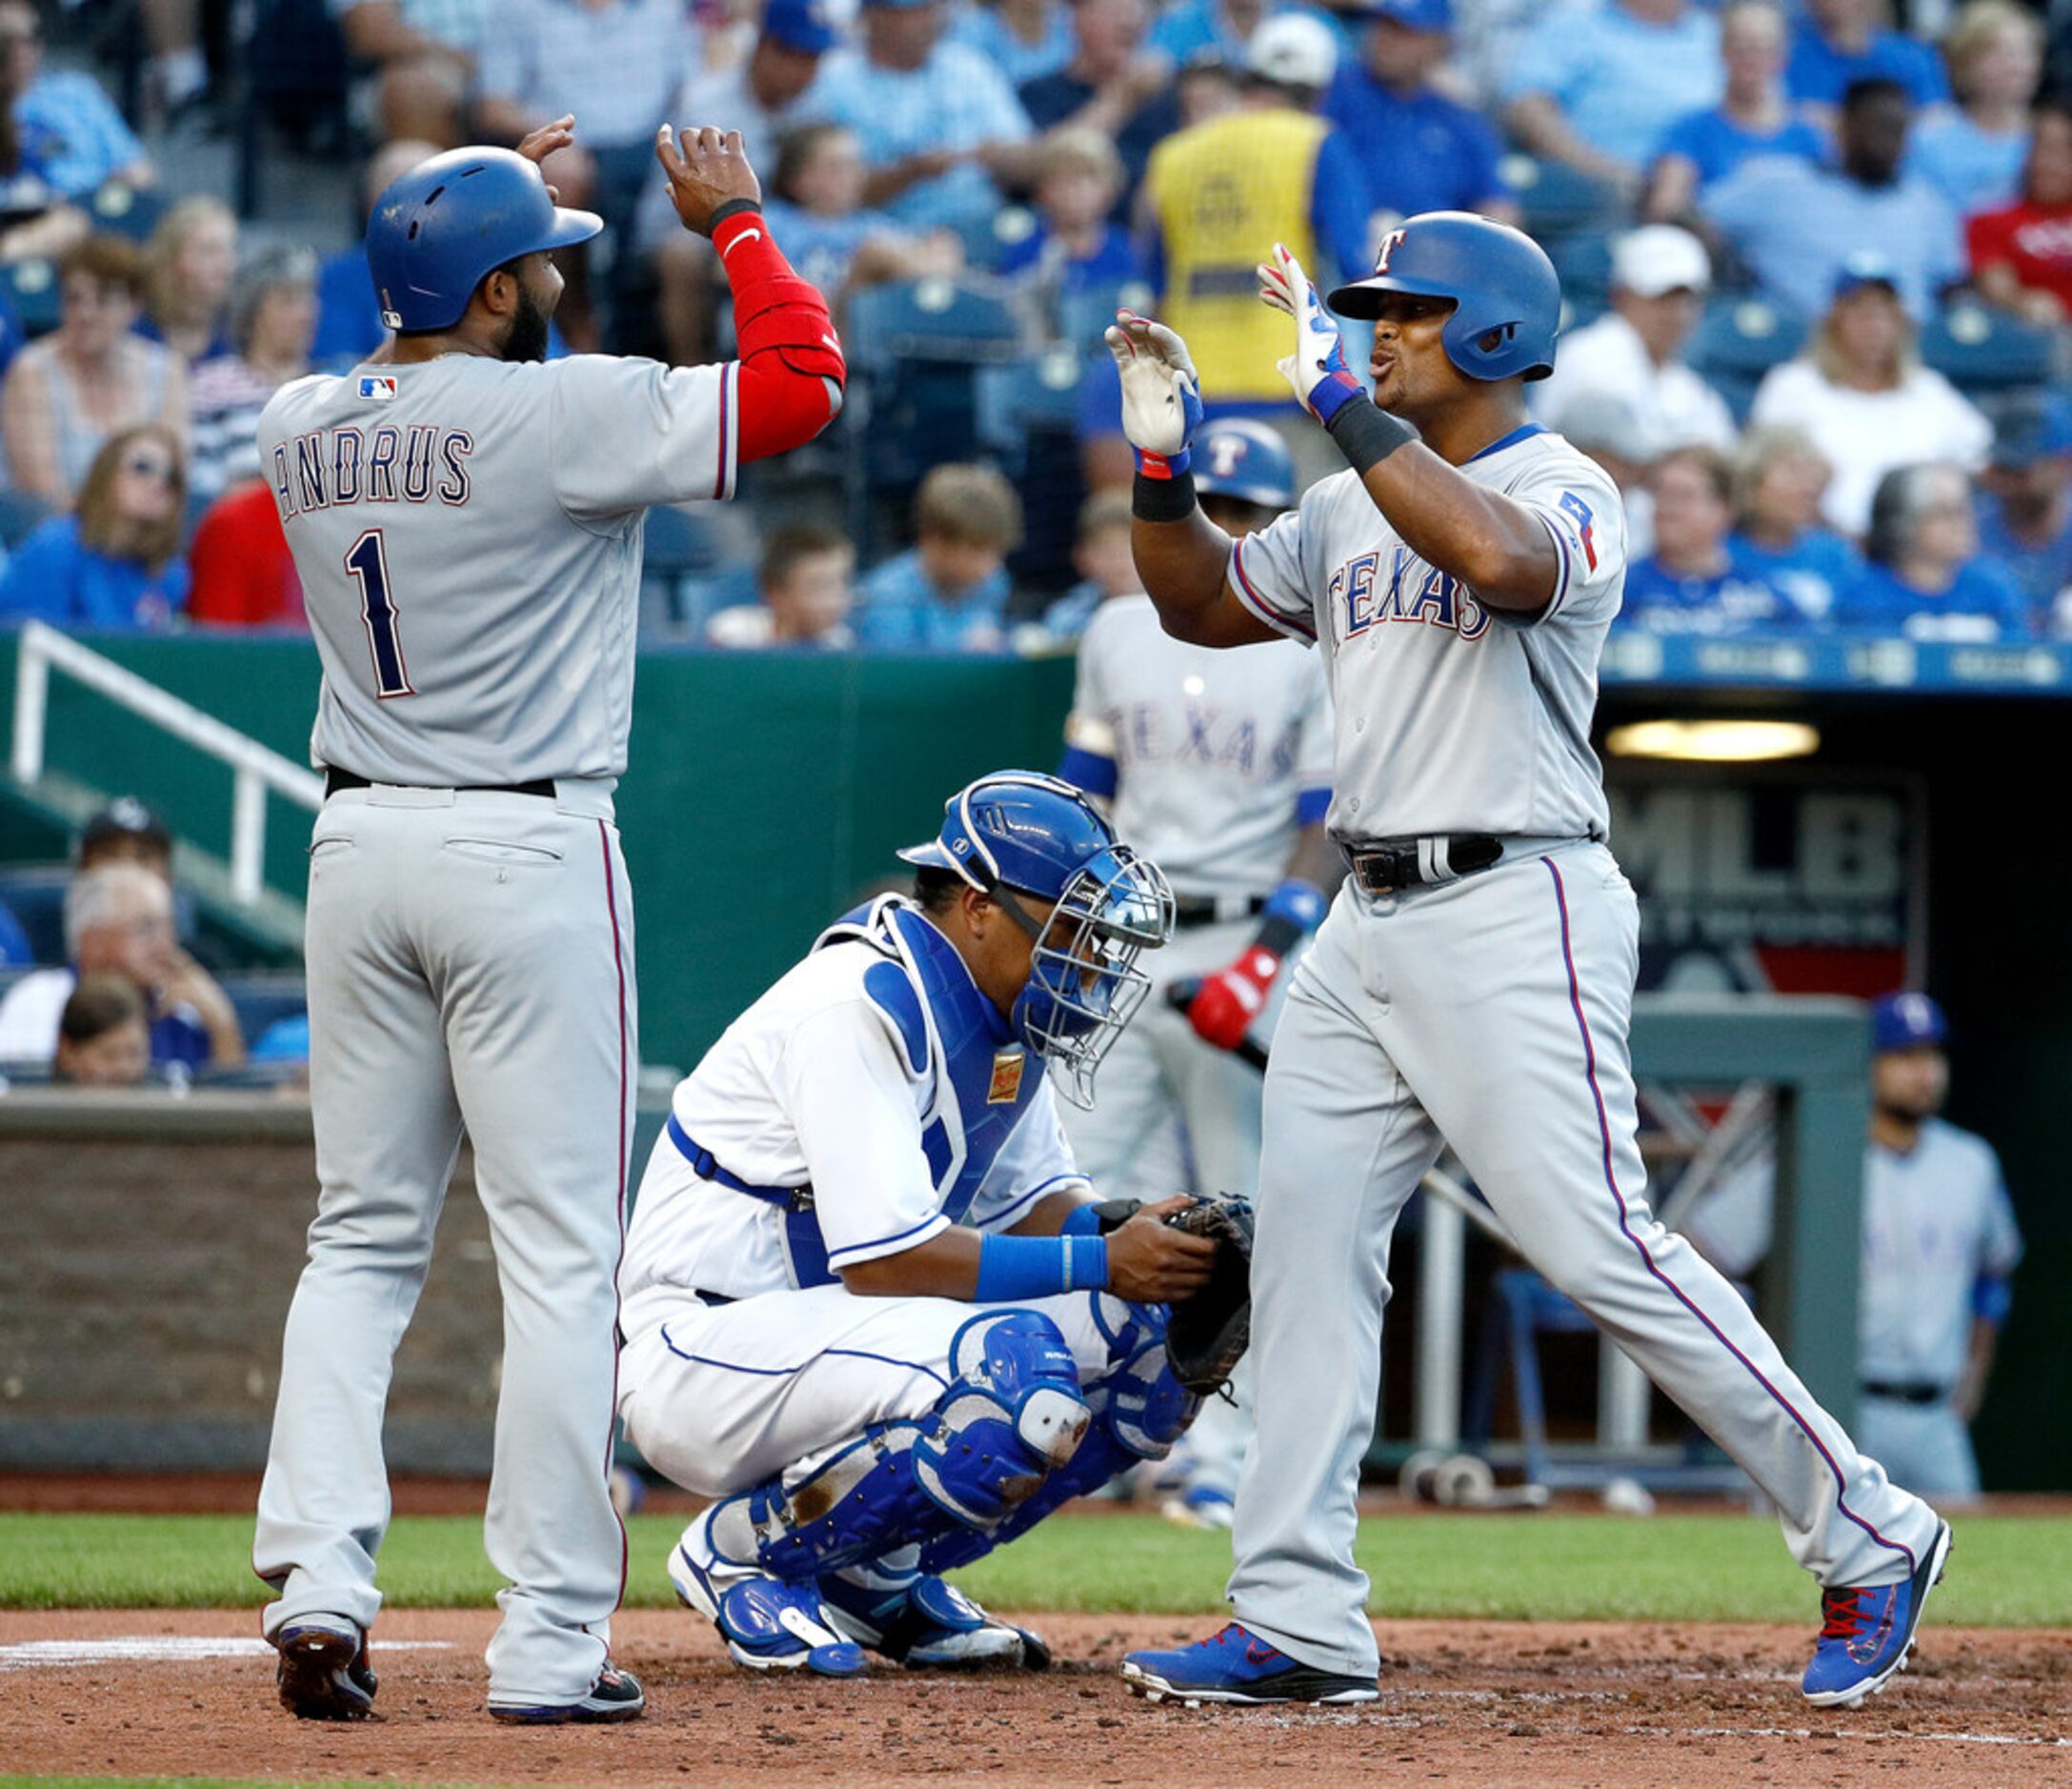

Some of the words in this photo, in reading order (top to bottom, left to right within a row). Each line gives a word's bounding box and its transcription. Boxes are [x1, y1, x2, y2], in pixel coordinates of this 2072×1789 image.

[1376, 229, 1406, 274] T
[273, 425, 474, 522] ANDRUS
[1208, 433, 1247, 476] T
[345, 528, 415, 699] 1
